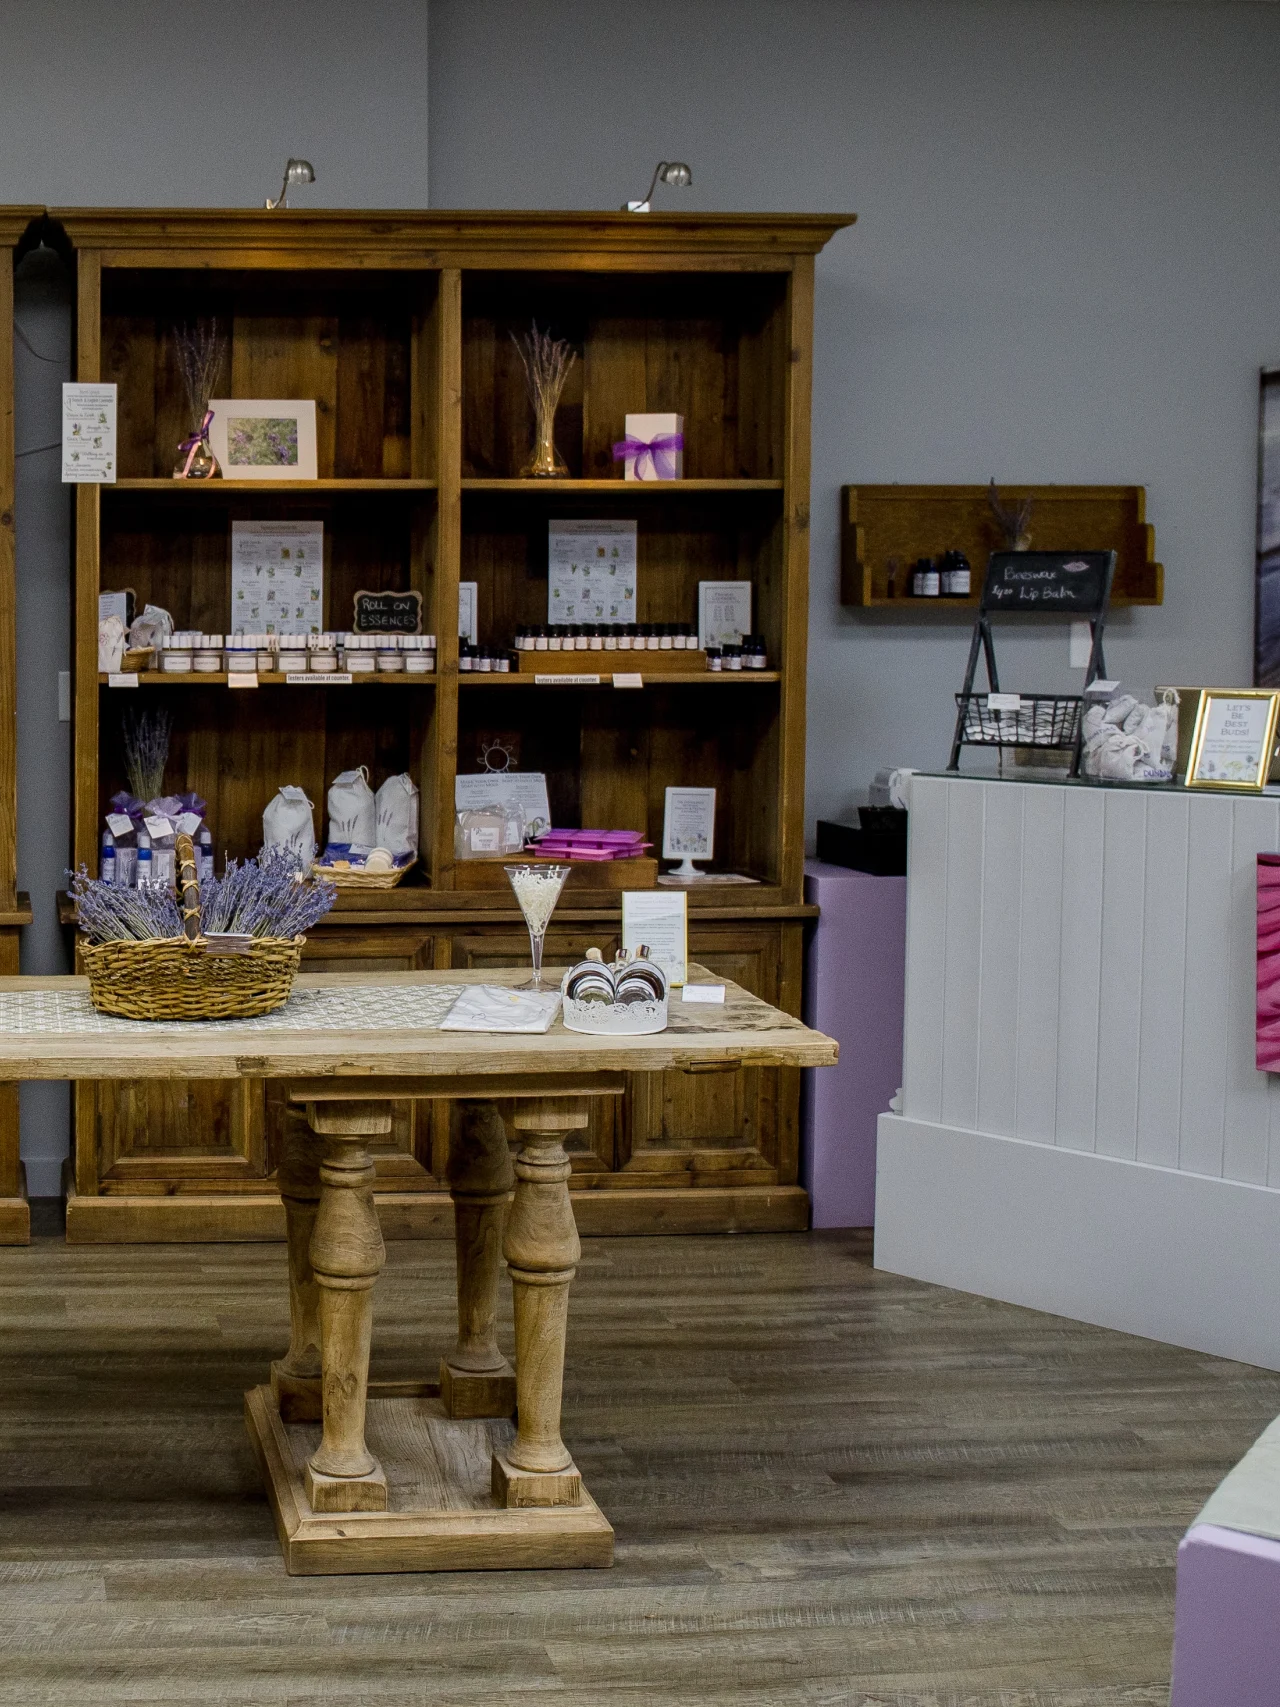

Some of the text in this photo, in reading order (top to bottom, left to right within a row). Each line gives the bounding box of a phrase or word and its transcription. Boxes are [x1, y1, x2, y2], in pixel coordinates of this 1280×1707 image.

[1004, 566, 1058, 581] Beeswax
[1019, 586, 1039, 601] Lip
[1042, 586, 1077, 600] Balm
[362, 598, 411, 611] ROLL ON
[360, 614, 416, 627] ESSENCES
[287, 674, 304, 682] Testers
[304, 674, 326, 682] available
[326, 674, 332, 682] at
[1226, 703, 1252, 712] LET'S
[1231, 712, 1244, 720] BE
[1224, 720, 1248, 728] BEST
[1220, 728, 1250, 736] BUDS!
